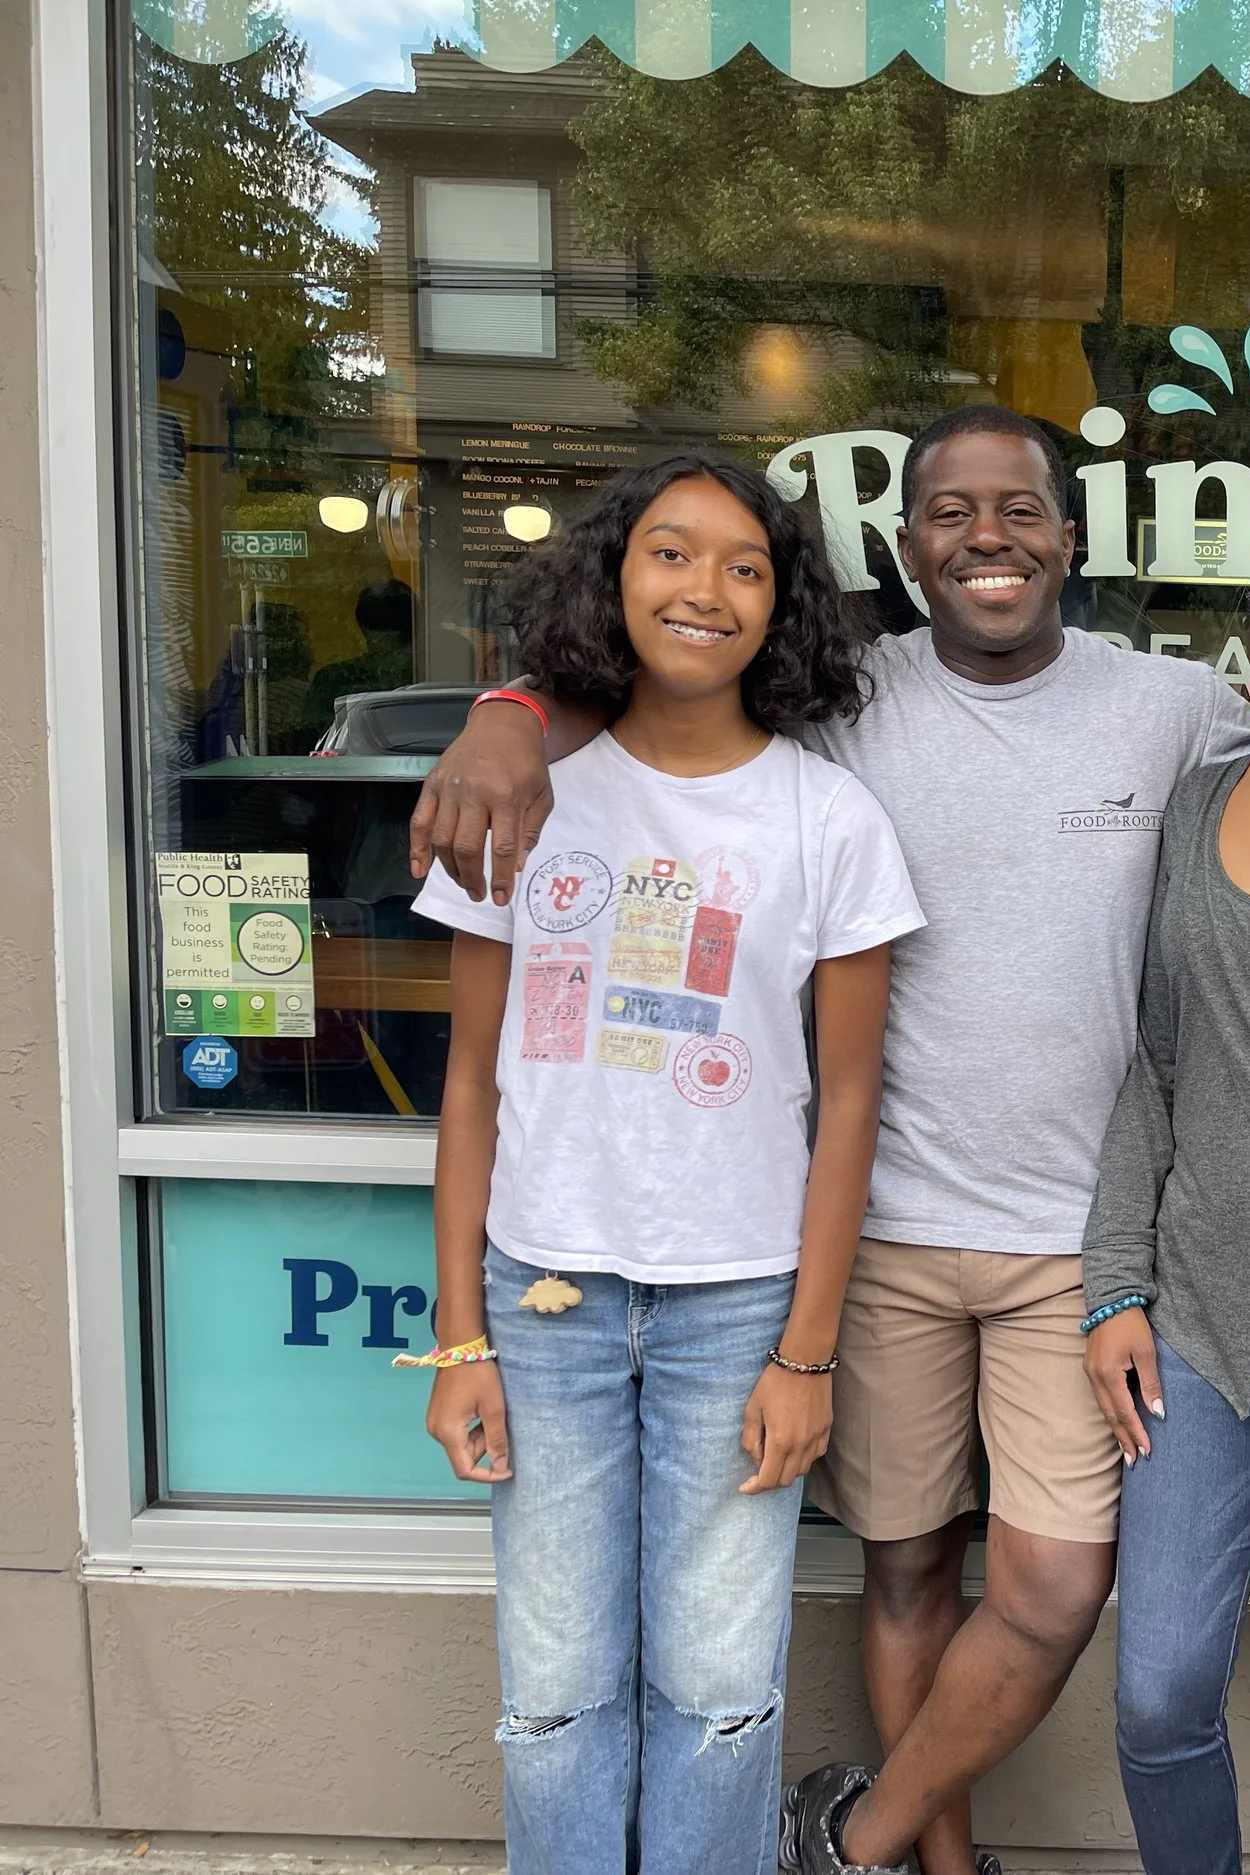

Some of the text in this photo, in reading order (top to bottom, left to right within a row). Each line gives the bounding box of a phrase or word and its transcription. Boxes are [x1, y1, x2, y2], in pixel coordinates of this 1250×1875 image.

[512, 422, 551, 432] RAINDROP
[461, 438, 530, 450] LEMON MERINGUE
[552, 442, 601, 452] CHOCOLATE
[462, 473, 491, 483] MANGO
[462, 491, 507, 501] BLUEBERRY
[462, 507, 495, 517] VANILLA
[462, 525, 490, 534] SALTED
[462, 543, 489, 552] PEACH
[490, 544, 526, 553] COBBLER
[1193, 545, 1222, 556] OOD
[1061, 815, 1106, 829] FOOD
[1122, 815, 1163, 828] ROOTS
[157, 853, 223, 863] Public Health
[158, 873, 248, 898] FOOD
[251, 875, 310, 888] SAFETY
[251, 887, 312, 899] RATING
[623, 875, 693, 902] NYC
[184, 906, 209, 918] This
[183, 921, 211, 933] food
[256, 918, 283, 929] Food
[171, 936, 224, 948] business
[253, 930, 287, 942] Safety
[252, 942, 289, 953] Rating:
[192, 952, 203, 963] is
[250, 954, 292, 966] Pending
[166, 966, 230, 980] permitted
[567, 965, 587, 984] A
[622, 996, 662, 1024] NYC
[191, 1047, 231, 1067] ADT
[282, 1257, 439, 1349] Pr
